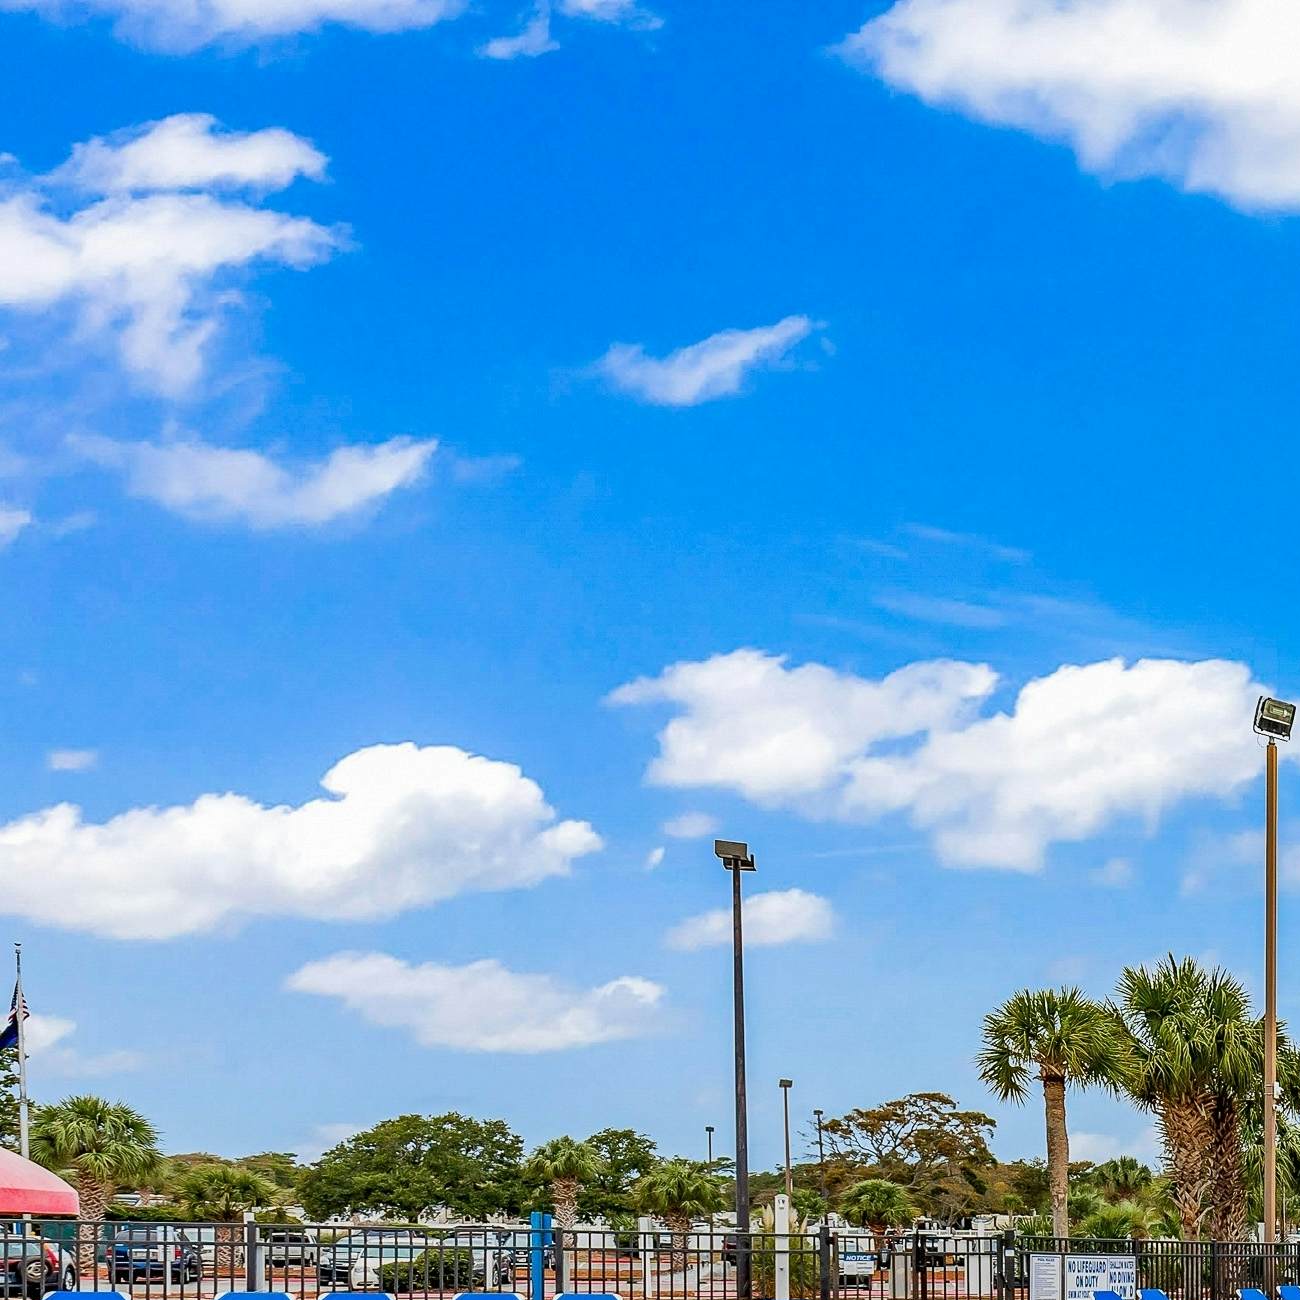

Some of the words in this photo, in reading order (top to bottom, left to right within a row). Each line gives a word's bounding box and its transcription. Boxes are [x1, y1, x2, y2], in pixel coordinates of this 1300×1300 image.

[1068, 1261, 1076, 1273] NO
[1077, 1261, 1107, 1273] LIFEGUARD
[1076, 1276, 1084, 1287] ON
[1085, 1276, 1099, 1287] DUTY
[1110, 1272, 1117, 1283] NO
[1117, 1272, 1134, 1283] DIVING
